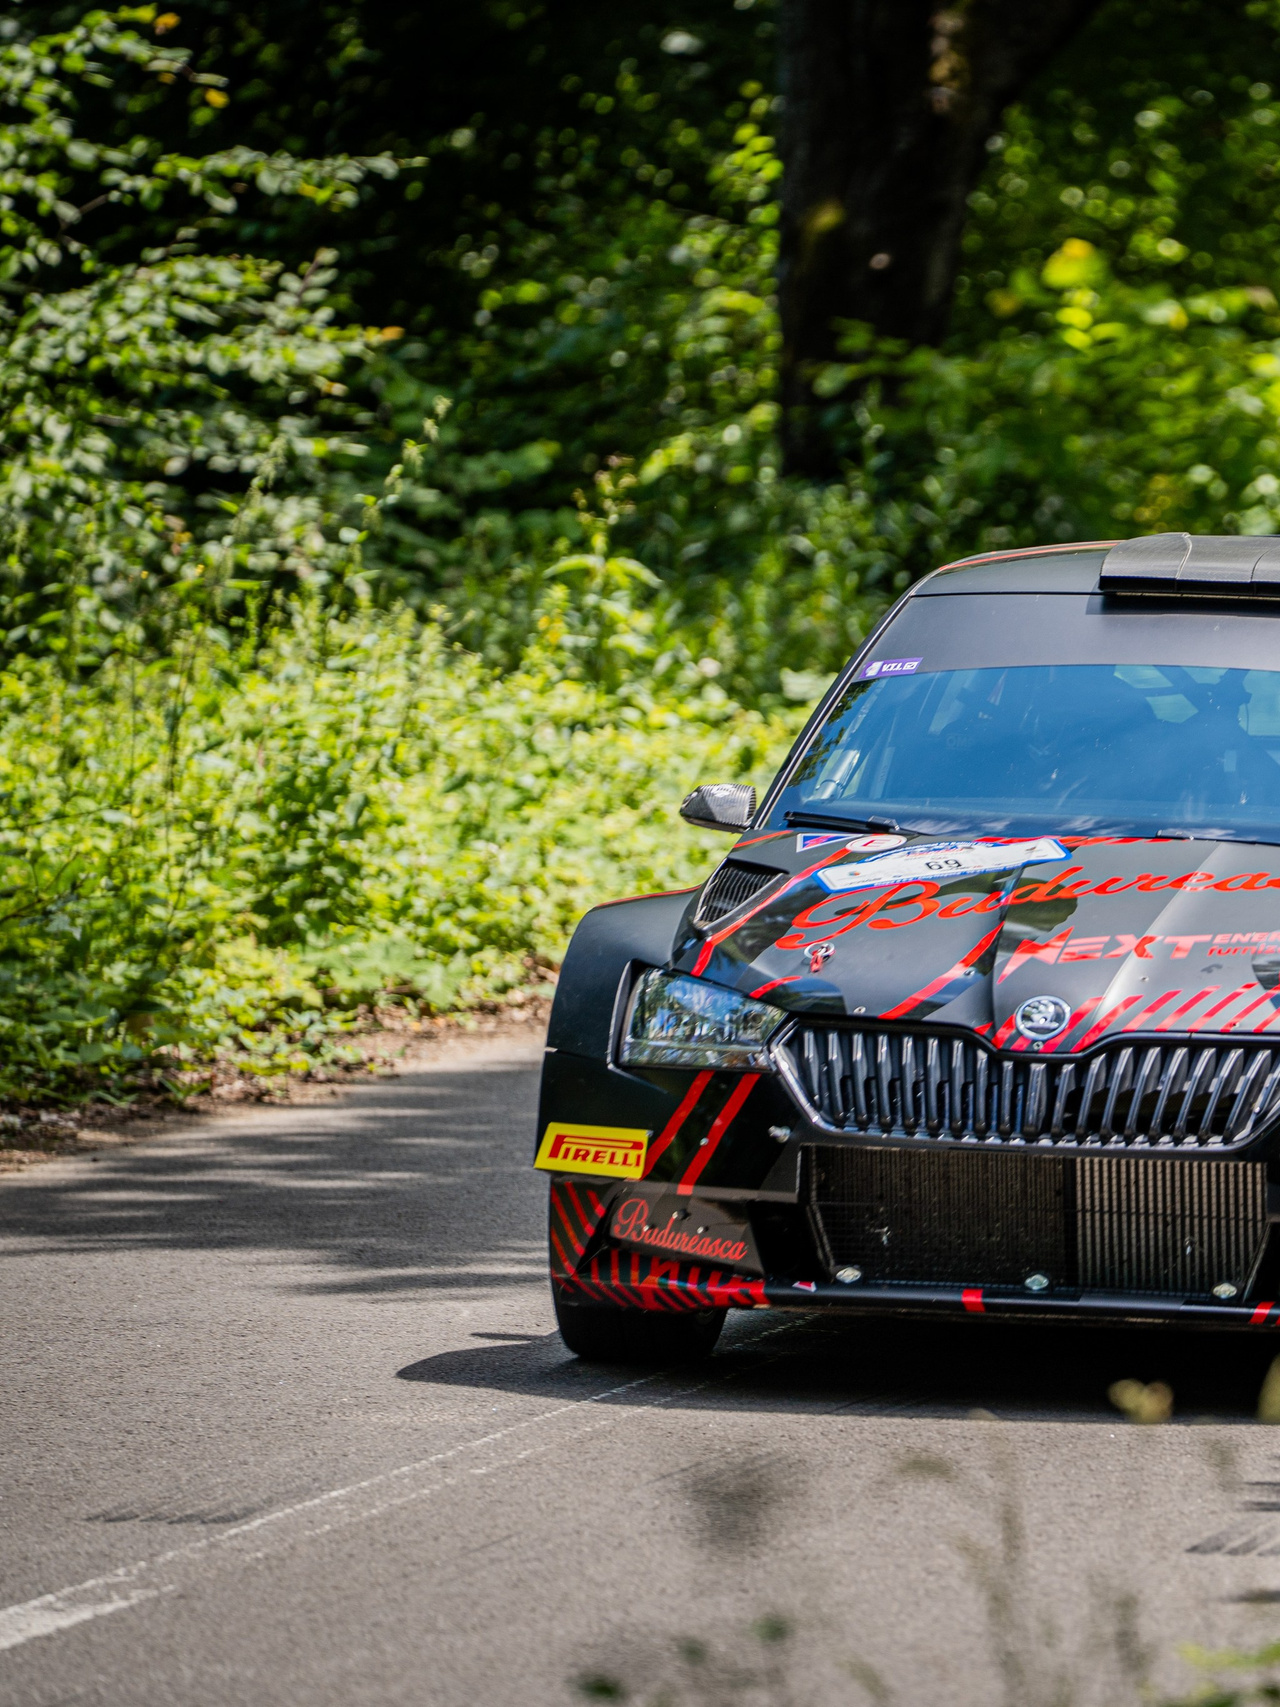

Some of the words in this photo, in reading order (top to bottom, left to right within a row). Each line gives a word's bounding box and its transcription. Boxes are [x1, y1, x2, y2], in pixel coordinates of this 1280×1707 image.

[924, 858, 963, 871] 69
[999, 925, 1214, 984] NEXT
[548, 1134, 645, 1168] PIRELLI
[612, 1198, 748, 1261] Budureasca
